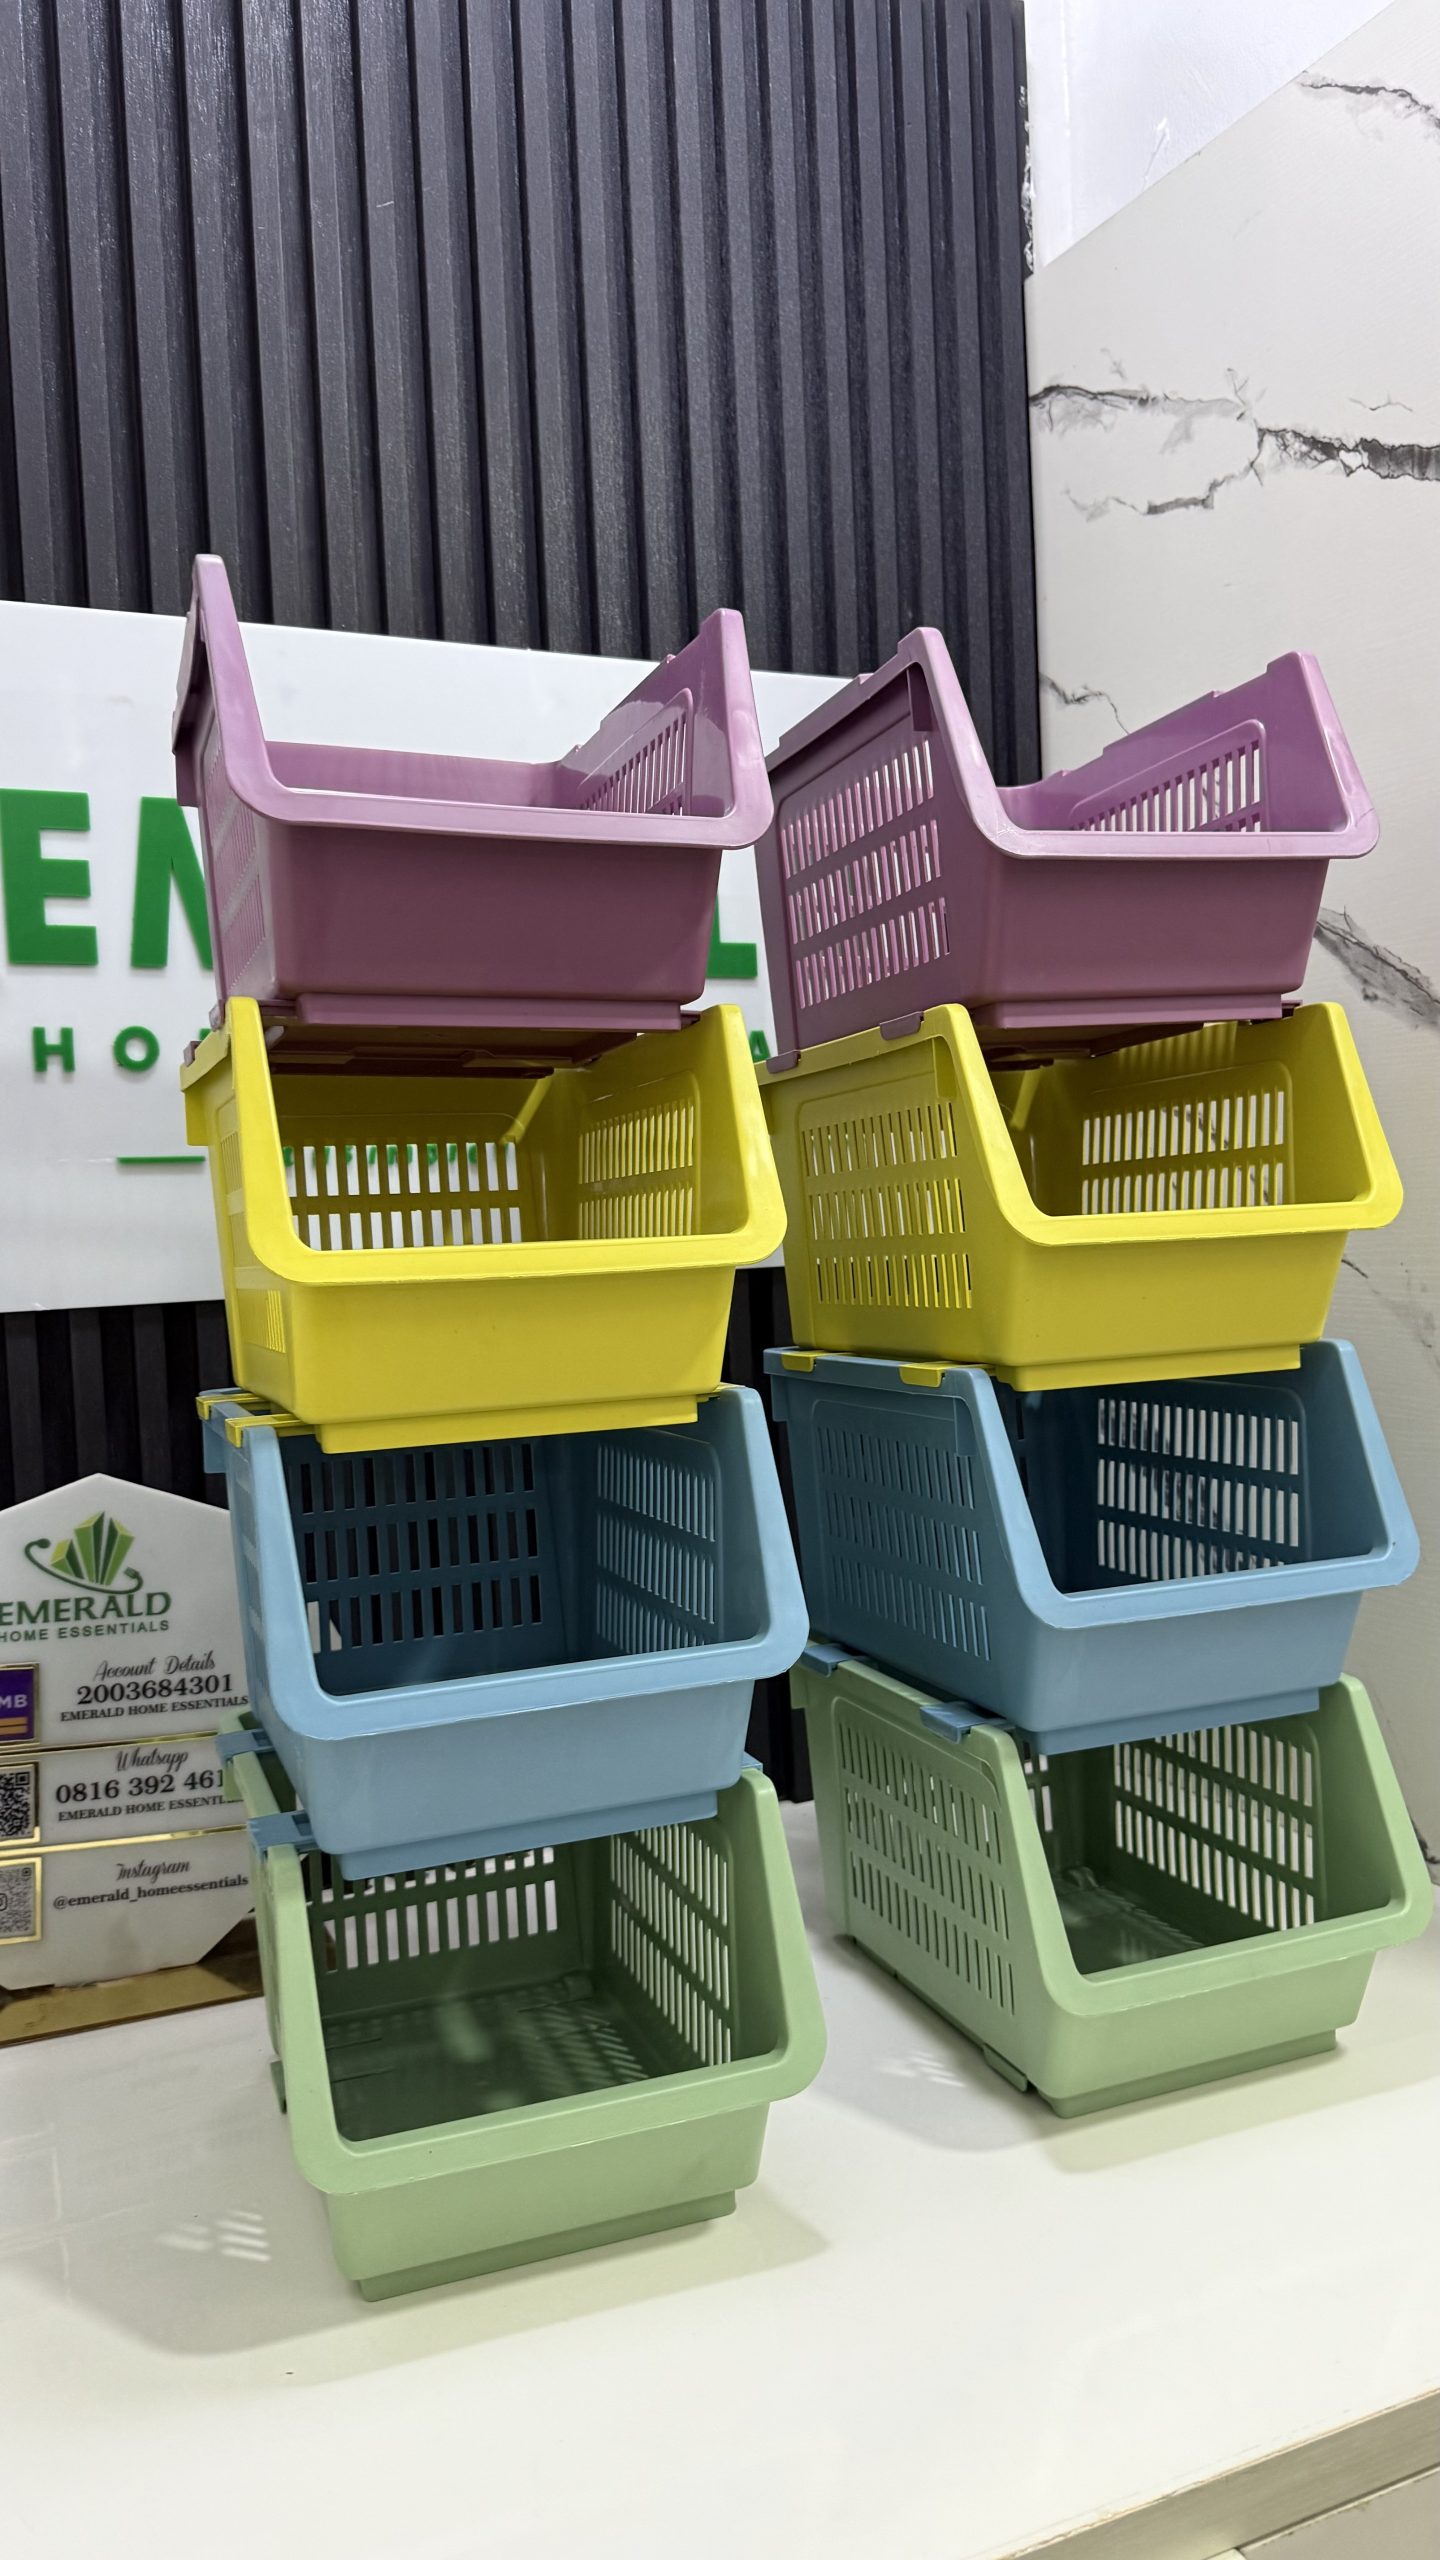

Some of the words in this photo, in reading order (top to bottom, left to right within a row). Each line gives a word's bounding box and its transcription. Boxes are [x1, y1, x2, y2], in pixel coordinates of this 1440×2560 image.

[0, 1591, 172, 1626] EMERALD
[58, 1620, 170, 1639] ESSENTIALS
[93, 1657, 157, 1682] Account
[165, 1650, 216, 1675] Details
[0, 1693, 28, 1709] MB
[76, 1673, 233, 1706] 2003684301
[60, 1706, 125, 1722] EMERALD
[128, 1702, 168, 1716] HOME
[171, 1695, 249, 1712] ESSENTIALS
[116, 1747, 189, 1773] Whatsapp
[56, 1779, 120, 1804] 0816
[129, 1774, 175, 1797] 392
[183, 1769, 223, 1791] 461
[58, 1805, 123, 1822] EMERALD
[125, 1800, 166, 1815] HOME
[169, 1795, 225, 1810] ESSENTI
[116, 1859, 191, 1884] Instagram
[52, 1874, 249, 1910] @emerald_homeessentials
